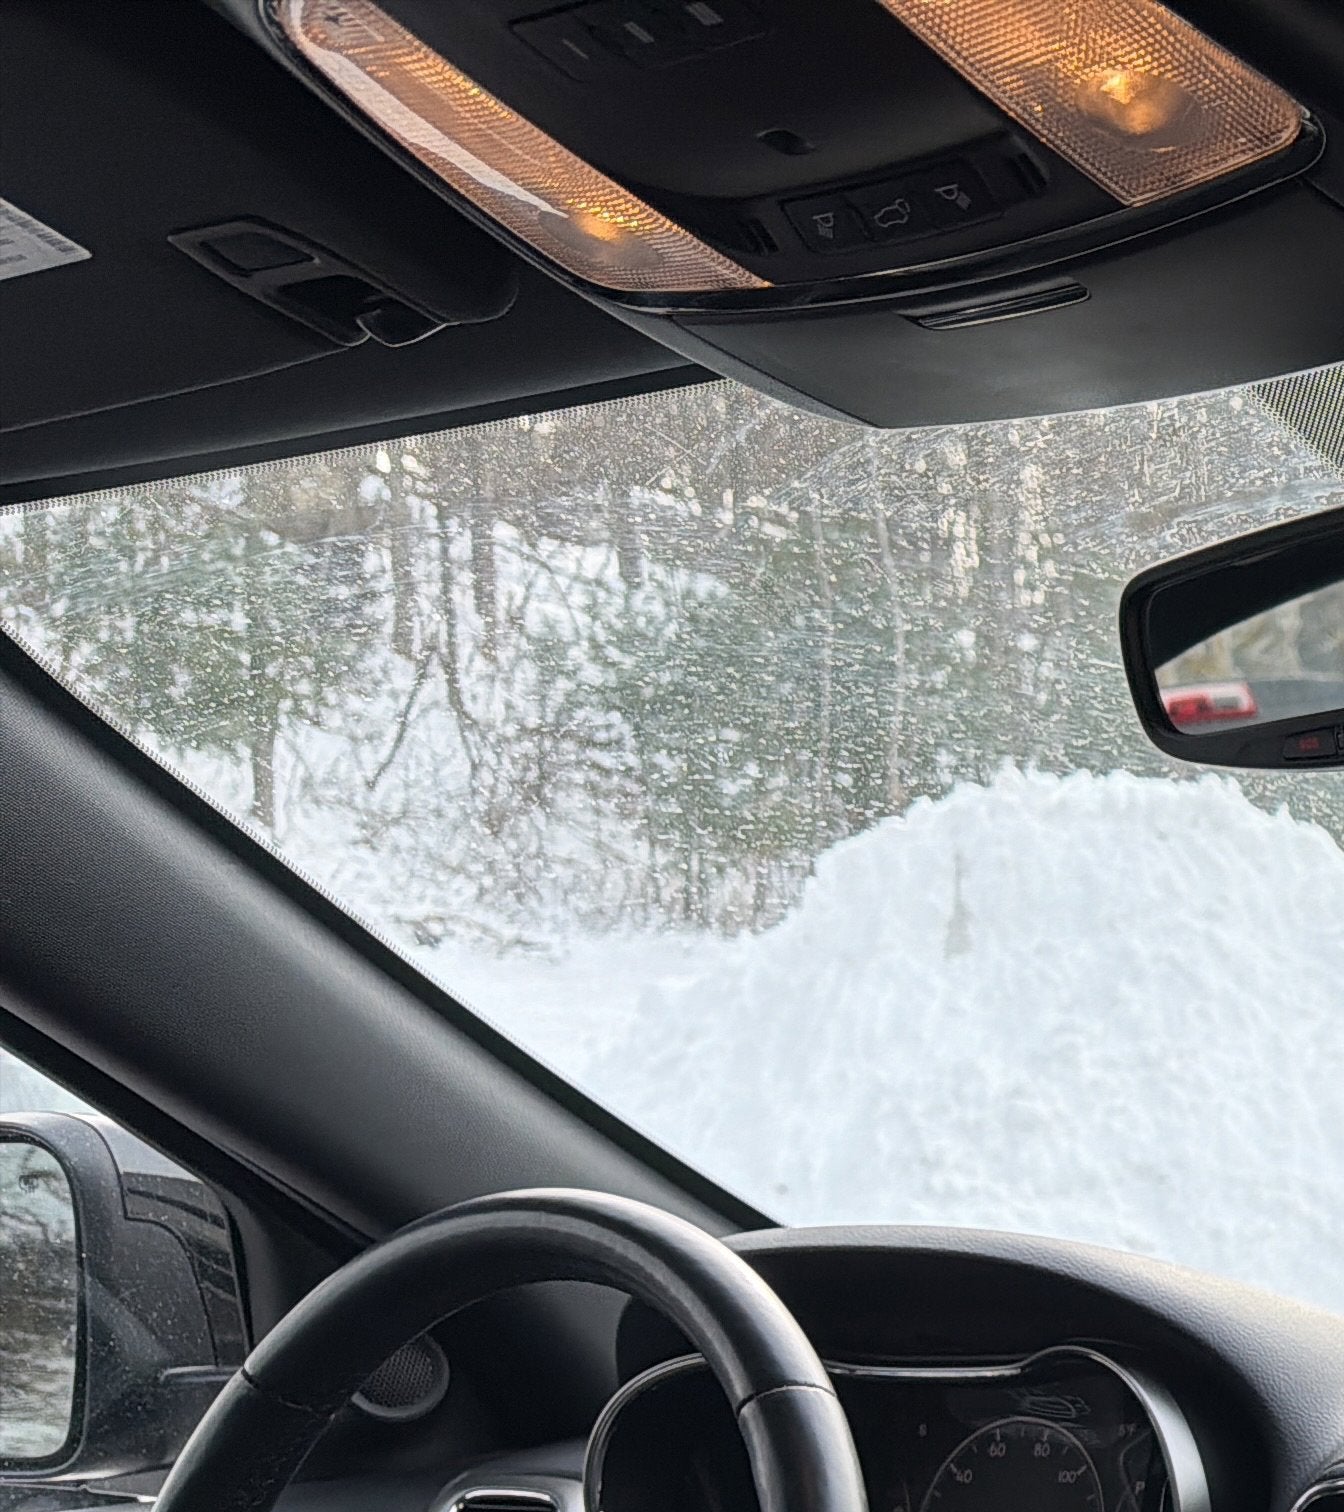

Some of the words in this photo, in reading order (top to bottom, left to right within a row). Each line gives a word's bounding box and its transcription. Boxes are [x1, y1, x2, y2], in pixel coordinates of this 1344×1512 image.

[990, 1443, 1006, 1457] 60
[1034, 1443, 1050, 1457] 80
[1058, 1471, 1076, 1483] 100
